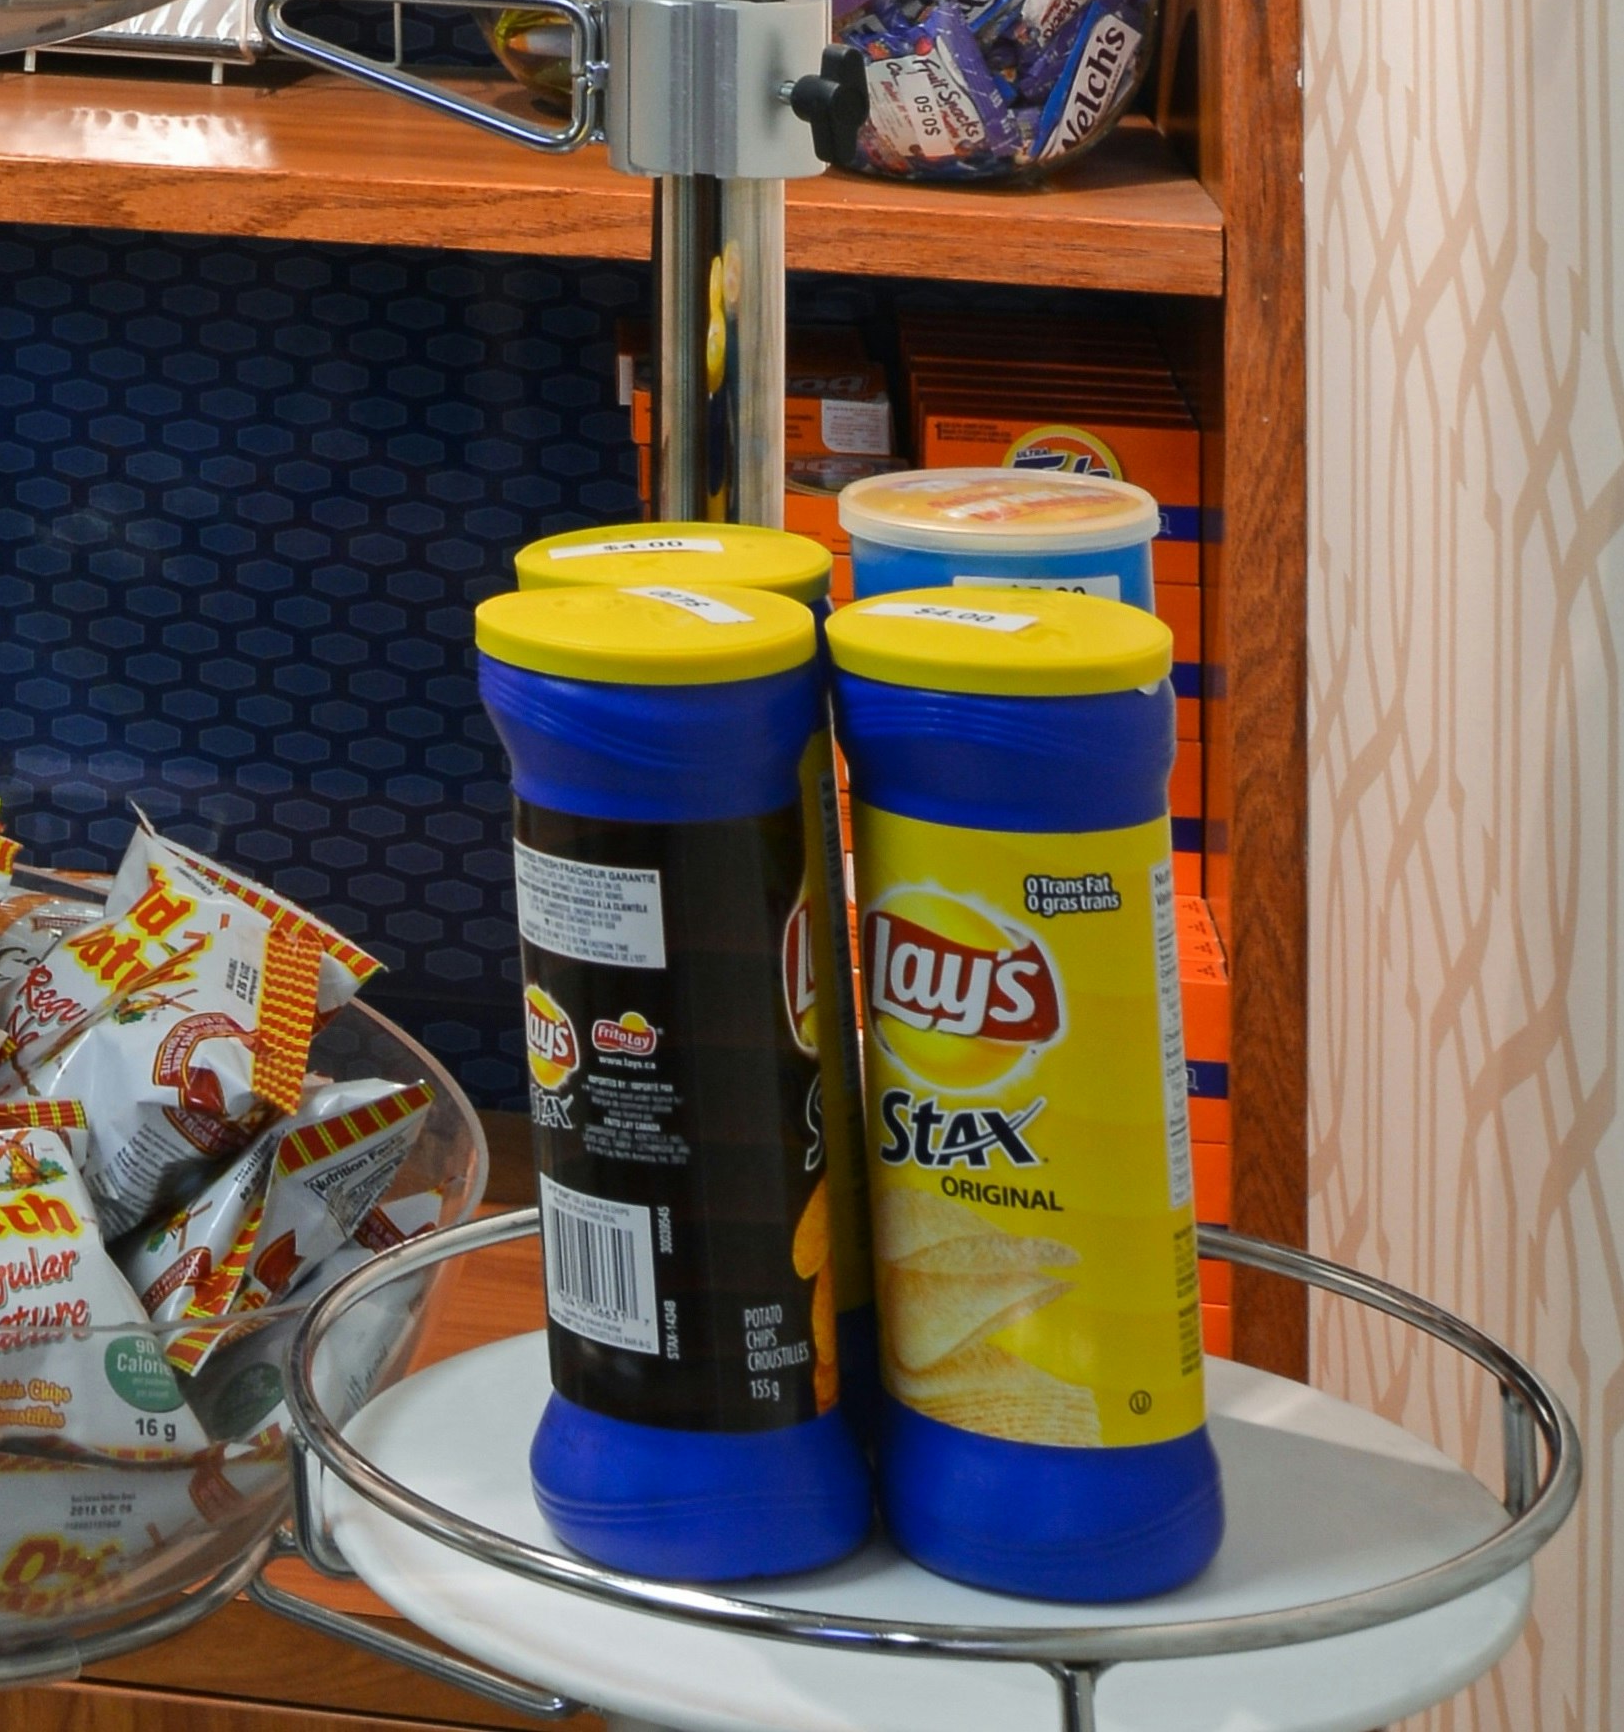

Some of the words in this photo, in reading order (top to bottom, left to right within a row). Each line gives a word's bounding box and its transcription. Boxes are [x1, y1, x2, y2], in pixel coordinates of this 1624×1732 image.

[913, 96, 940, 136] $0.50
[939, 90, 979, 138] Snacks
[603, 540, 683, 552] $4.00
[913, 606, 995, 624] $4.00
[872, 916, 1040, 1036] Lay's
[599, 1056, 656, 1070] www.lays.ca
[941, 1175, 1064, 1211] ORIGINAL
[744, 1305, 782, 1328] POTATO
[136, 1418, 157, 1437] 16
